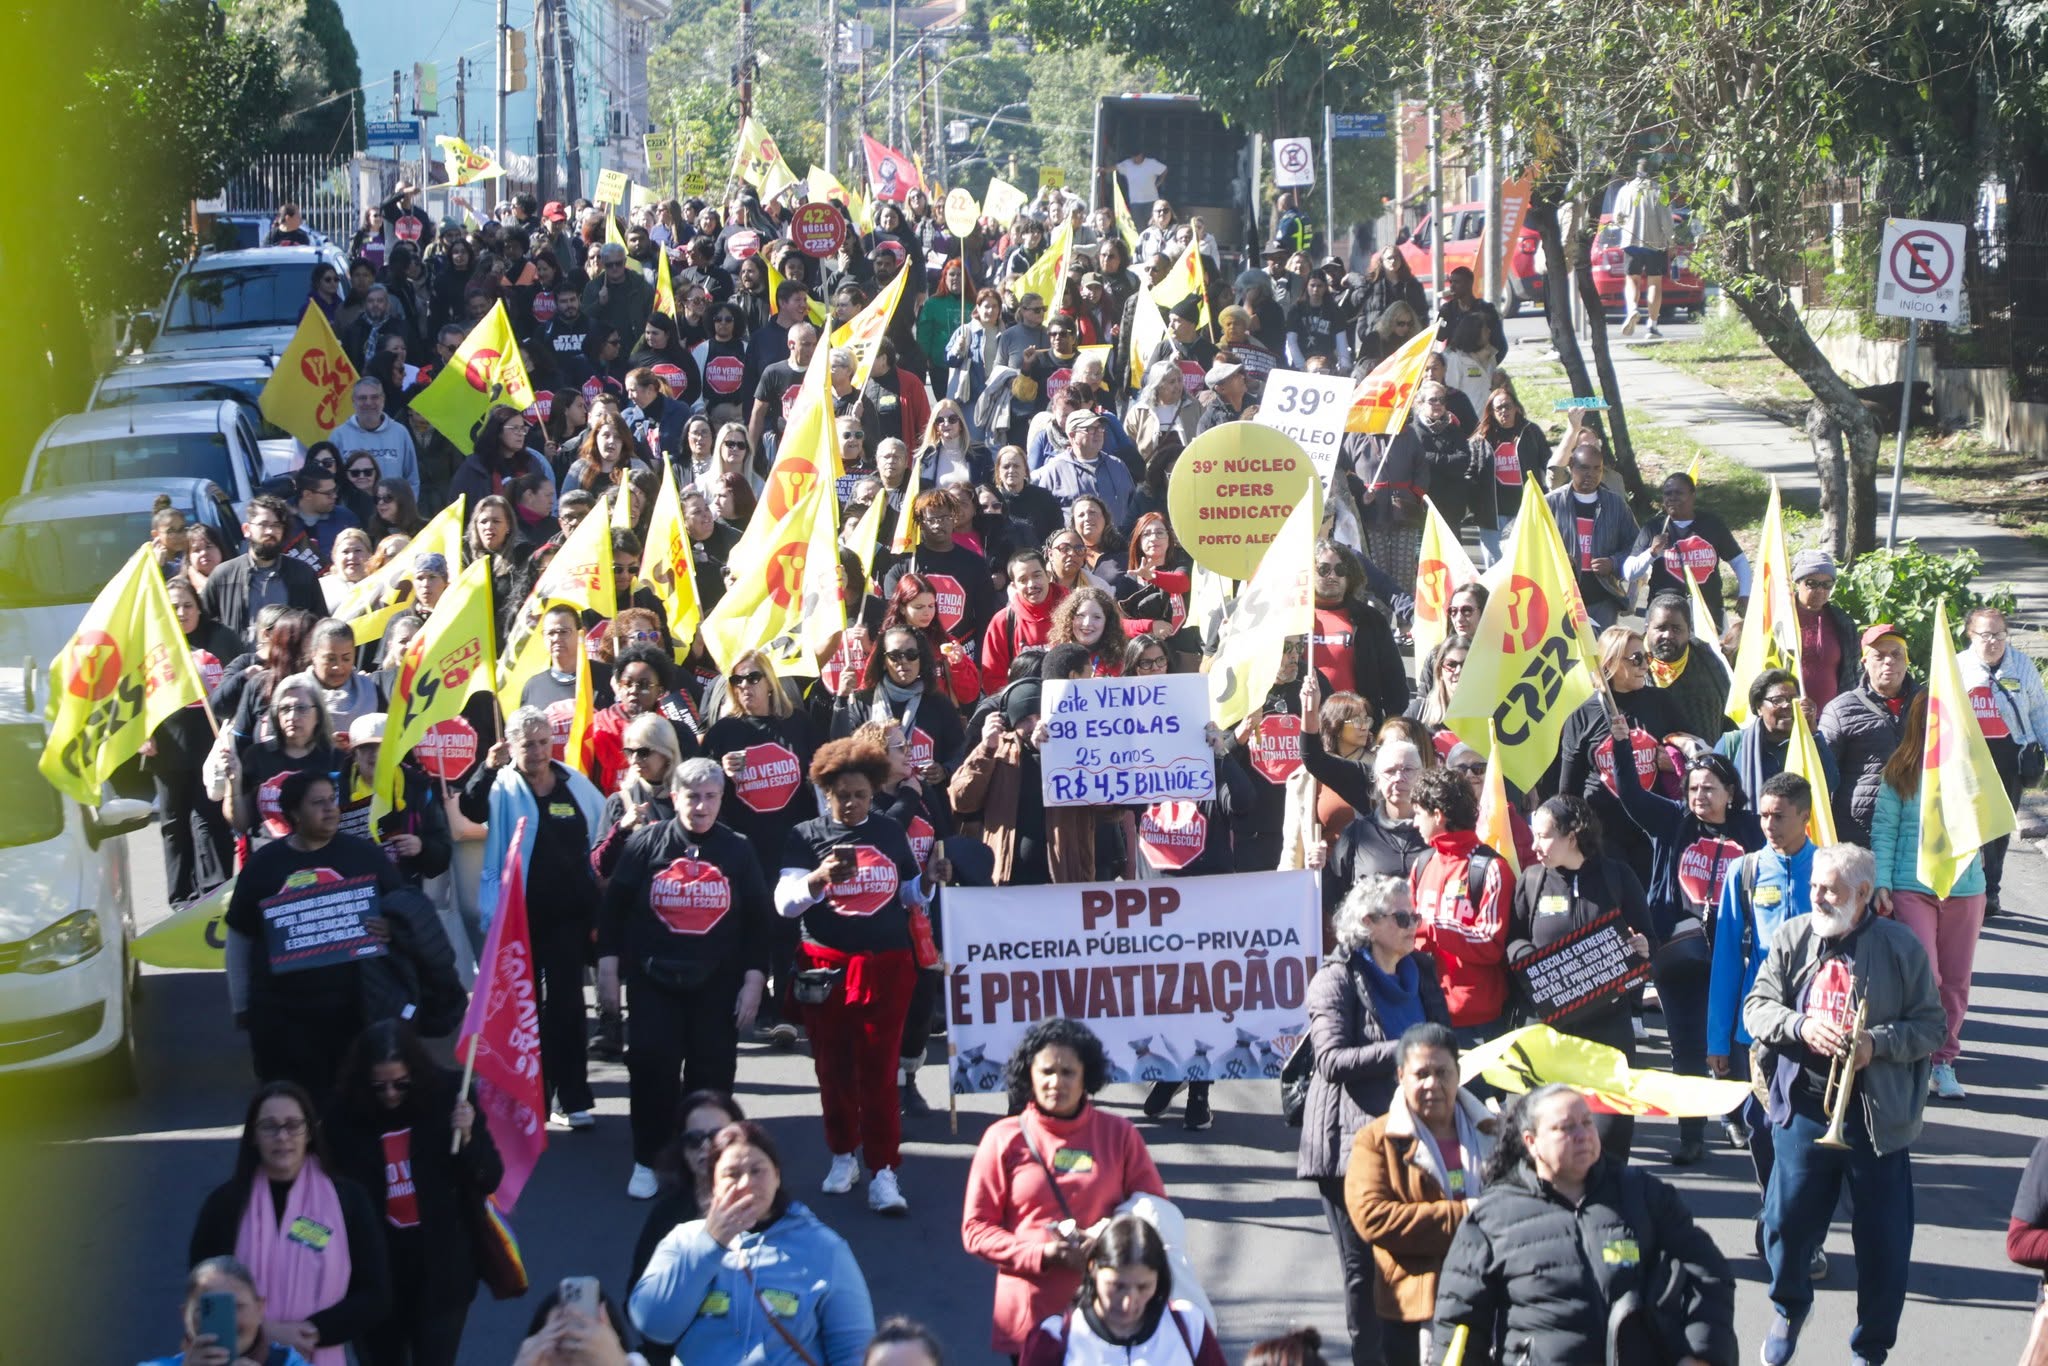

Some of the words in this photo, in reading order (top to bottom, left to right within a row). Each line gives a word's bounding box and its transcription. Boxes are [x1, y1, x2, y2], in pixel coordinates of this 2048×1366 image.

[1900, 300, 1934, 312] INÍCIO
[554, 343, 581, 352] WAR
[1277, 385, 1335, 415] 39º
[1224, 457, 1296, 473] NÚCLEO
[1216, 483, 1274, 497] CPERS
[1199, 505, 1294, 520] SINDICATO
[1199, 534, 1242, 545] PORTO
[1246, 533, 1278, 544] ALE
[1688, 548, 1715, 561] VENDA
[1051, 685, 1088, 714] Leite
[1095, 685, 1168, 708] VENDE
[1050, 721, 1077, 739] 98
[1086, 715, 1180, 737] ESCOLAS
[1280, 735, 1301, 750] VEN
[1076, 747, 1101, 766] 25
[1110, 748, 1155, 764] anos
[760, 759, 797, 778] VENDA
[745, 780, 770, 791] MINHA
[769, 774, 798, 788] ESCOLA
[1052, 770, 1088, 799] R$
[1095, 771, 1129, 803] 4,5
[1135, 765, 1213, 795] BILHÕES
[1171, 835, 1201, 847] ESCOLA
[1684, 850, 1708, 867] NÃO
[655, 878, 681, 895] NÃO
[685, 881, 726, 897] VENDA
[833, 882, 862, 895] MINHA
[864, 880, 896, 893] ESCOLA
[662, 896, 692, 907] MINHA
[693, 897, 727, 908] ESCOLA
[1081, 886, 1181, 930] PPP
[967, 940, 1081, 962] PARCERIA
[1086, 927, 1300, 956] PÚBLICO-PRIVADA
[1539, 948, 1573, 972] ESCOLAS
[1572, 926, 1618, 956] ENTREGUES
[1531, 976, 1548, 990] POR
[1547, 971, 1560, 983] 25
[1582, 951, 1602, 965] ISSO
[1600, 940, 1618, 957] NÃO
[1615, 936, 1625, 948] É
[1532, 985, 1566, 1004] GESTÃO,
[1563, 978, 1573, 989] É
[1569, 951, 1625, 986] PRIVATIZAÇÃO
[1552, 980, 1597, 1008] EDUCAÇÃO
[1593, 962, 1629, 987] PÚBLICA!
[950, 964, 973, 1025] É
